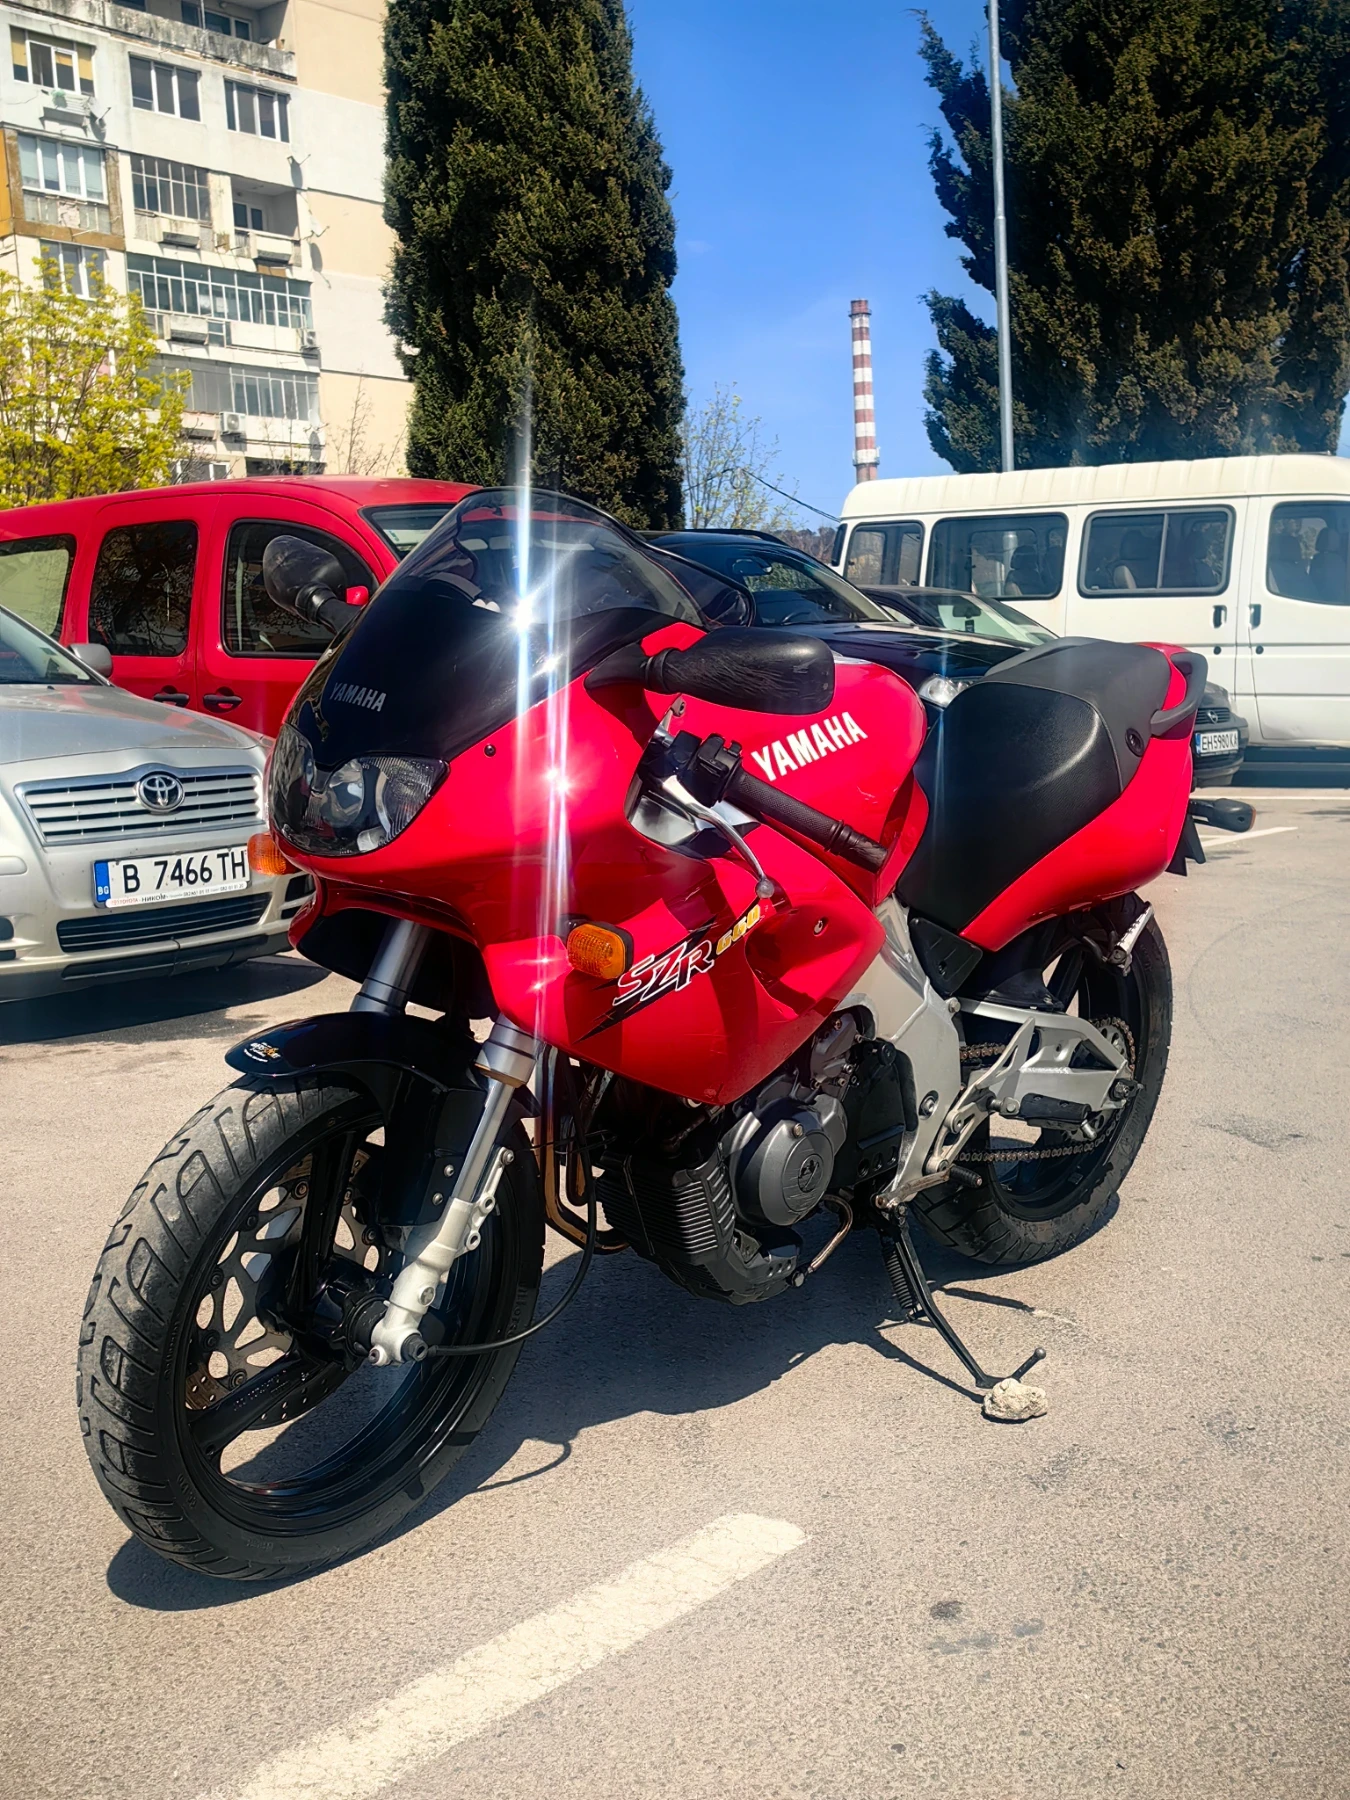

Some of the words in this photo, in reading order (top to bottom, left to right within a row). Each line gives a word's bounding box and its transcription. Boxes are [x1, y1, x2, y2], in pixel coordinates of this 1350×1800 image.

[330, 682, 386, 712] YAMAHA
[750, 711, 868, 782] YAMAHA
[97, 886, 109, 895] BG
[123, 864, 141, 893] B
[154, 855, 212, 890] 7466
[217, 850, 246, 881] TH
[612, 939, 714, 1006] SZR
[716, 904, 760, 956] 660
